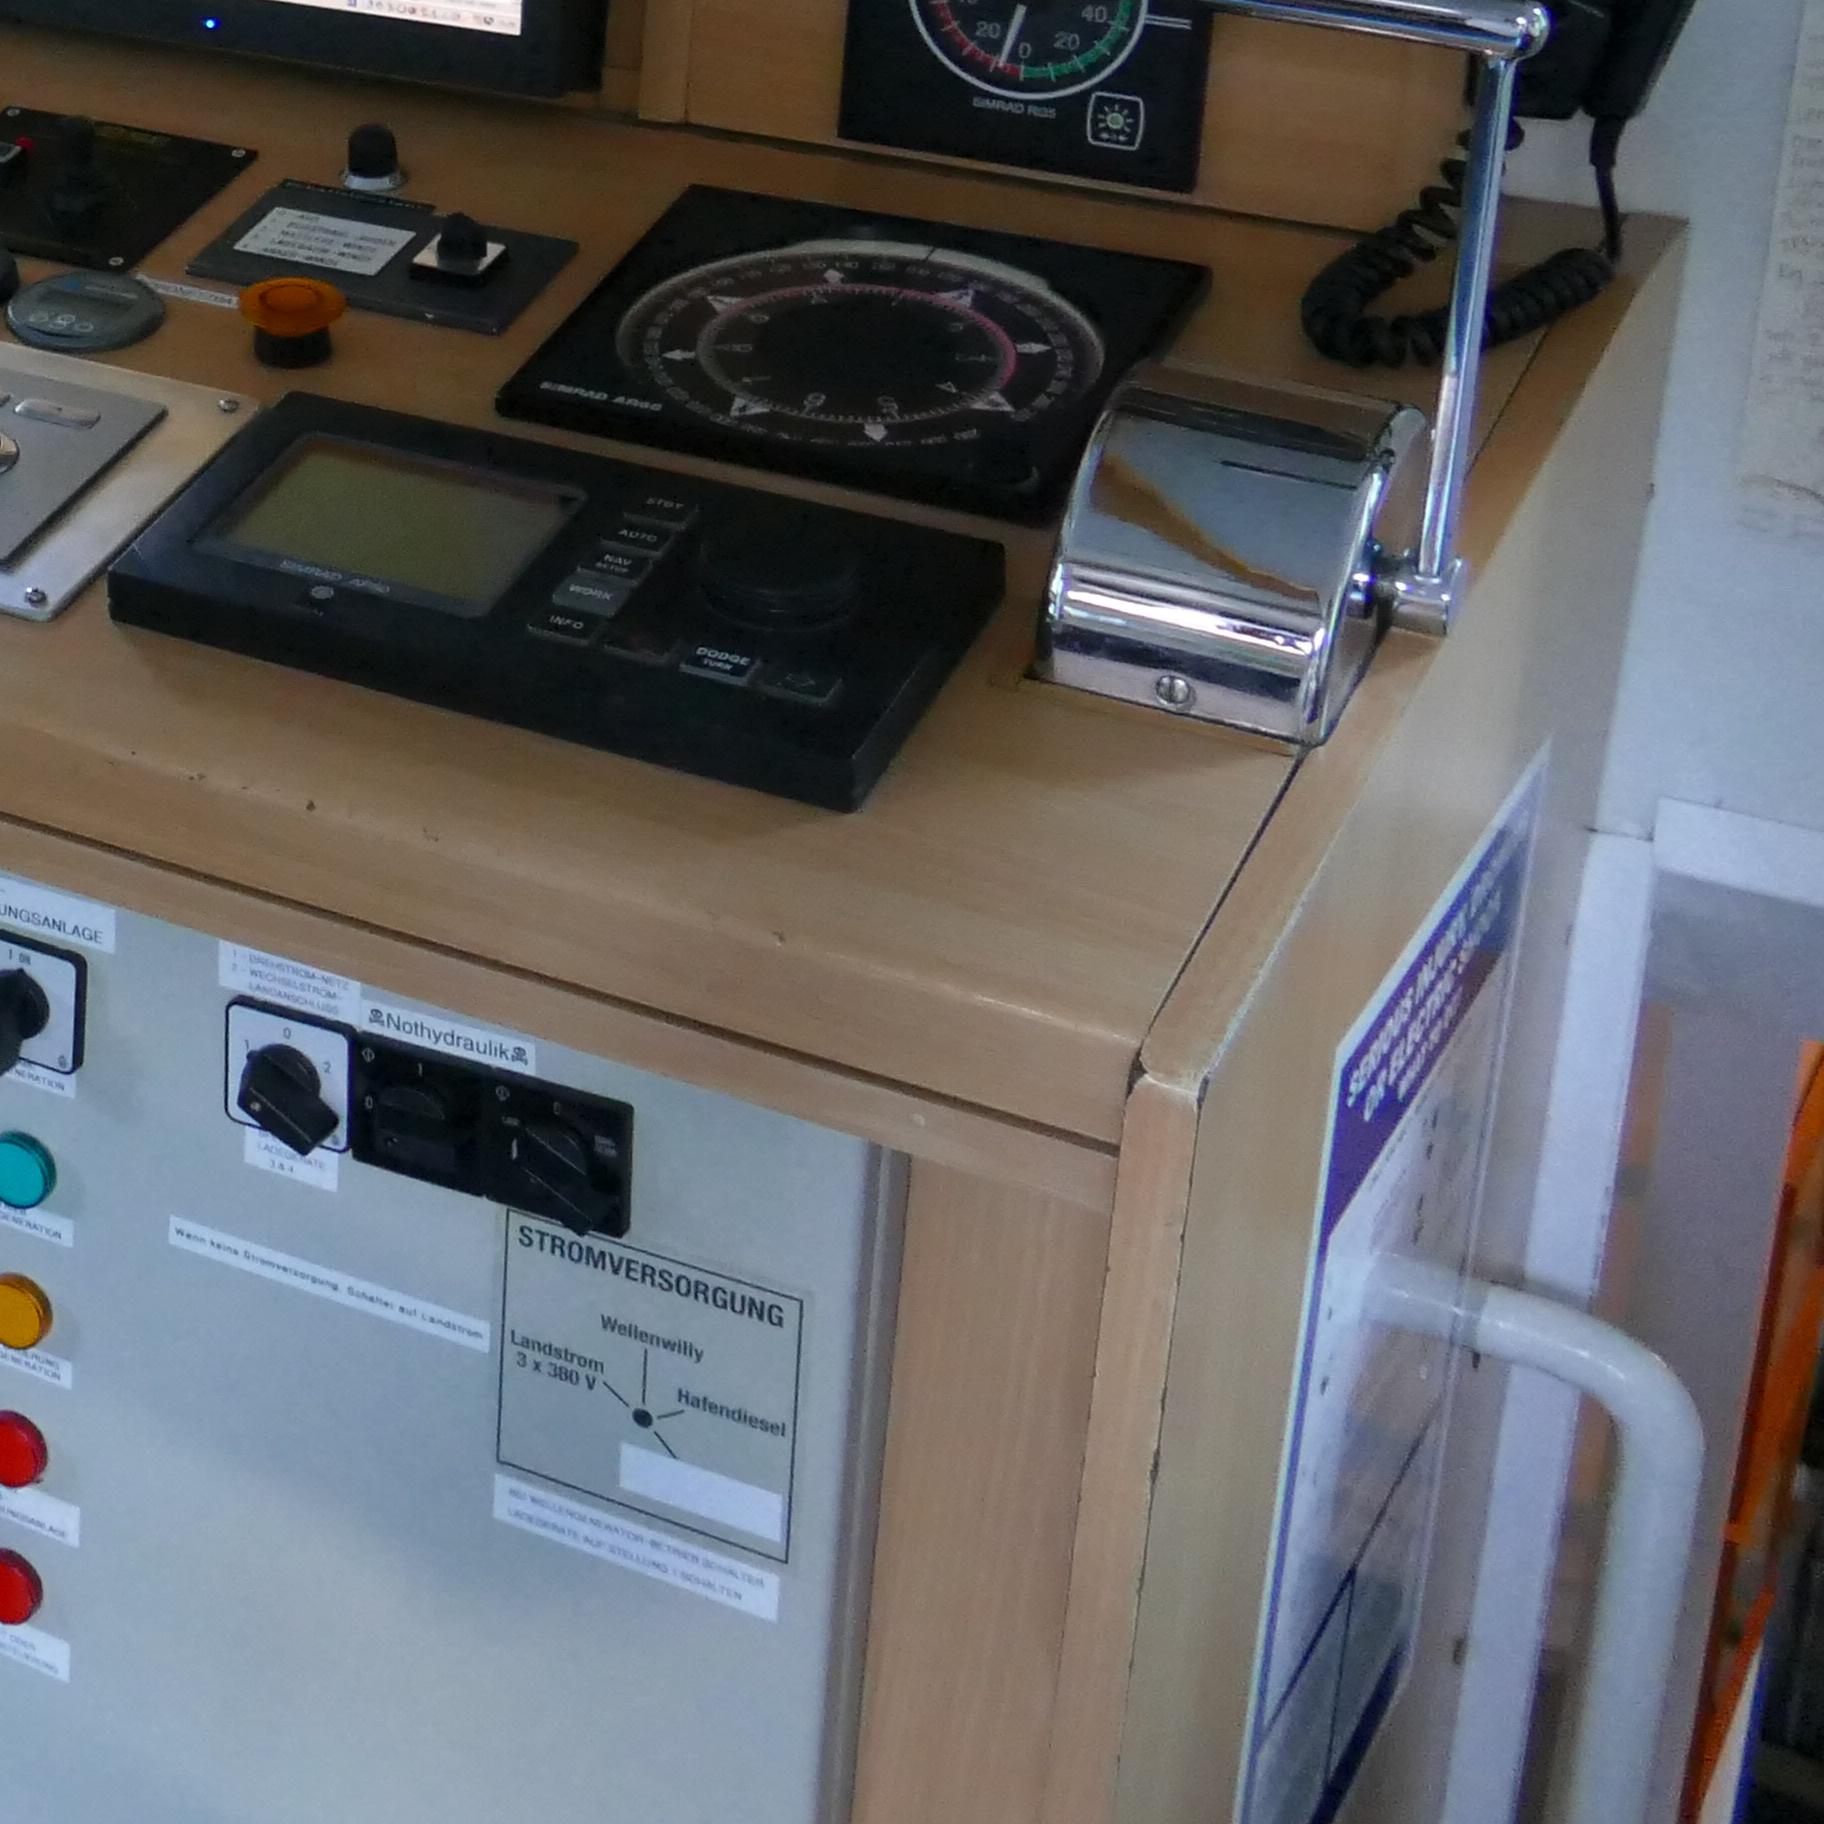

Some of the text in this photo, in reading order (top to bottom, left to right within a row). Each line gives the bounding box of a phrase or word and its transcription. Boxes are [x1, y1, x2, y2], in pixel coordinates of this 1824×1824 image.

[1080, 4, 1108, 24] 40
[975, 21, 1001, 40] 20
[1018, 42, 1032, 60] 0
[1053, 31, 1081, 51] 20
[972, 96, 1025, 115] SIMRAD
[538, 380, 608, 402] SIMRAD
[617, 528, 658, 544] AUTO
[603, 553, 633, 567] NAV
[568, 582, 614, 601] WORK
[548, 614, 585, 630] INFO
[695, 645, 752, 667] DODGE
[702, 658, 733, 671] TURN
[282, 1026, 292, 1039] 0
[385, 1011, 511, 1062] Nothydraulik
[1362, 1067, 1388, 1123] OR
[1387, 958, 1458, 1087] ELECTRIC
[1347, 984, 1415, 1109] SERIOUS
[323, 1060, 333, 1074] 2
[365, 1095, 373, 1109] 0
[174, 1226, 207, 1246] Wenn
[209, 1238, 240, 1257] keine
[398, 1305, 418, 1317] auf
[420, 1311, 484, 1340] Landstrom
[518, 1224, 785, 1328] STROMVERSORGUNG
[600, 1314, 704, 1364] Wellenwilly
[510, 1329, 604, 1374] Landstrom
[516, 1351, 597, 1391] 3 x 380 V
[677, 1387, 786, 1438] Hafendiesel
[582, 1534, 608, 1551] AUF
[608, 1544, 669, 1575] STELLUNG
[678, 1569, 743, 1602] SCHALTEN
